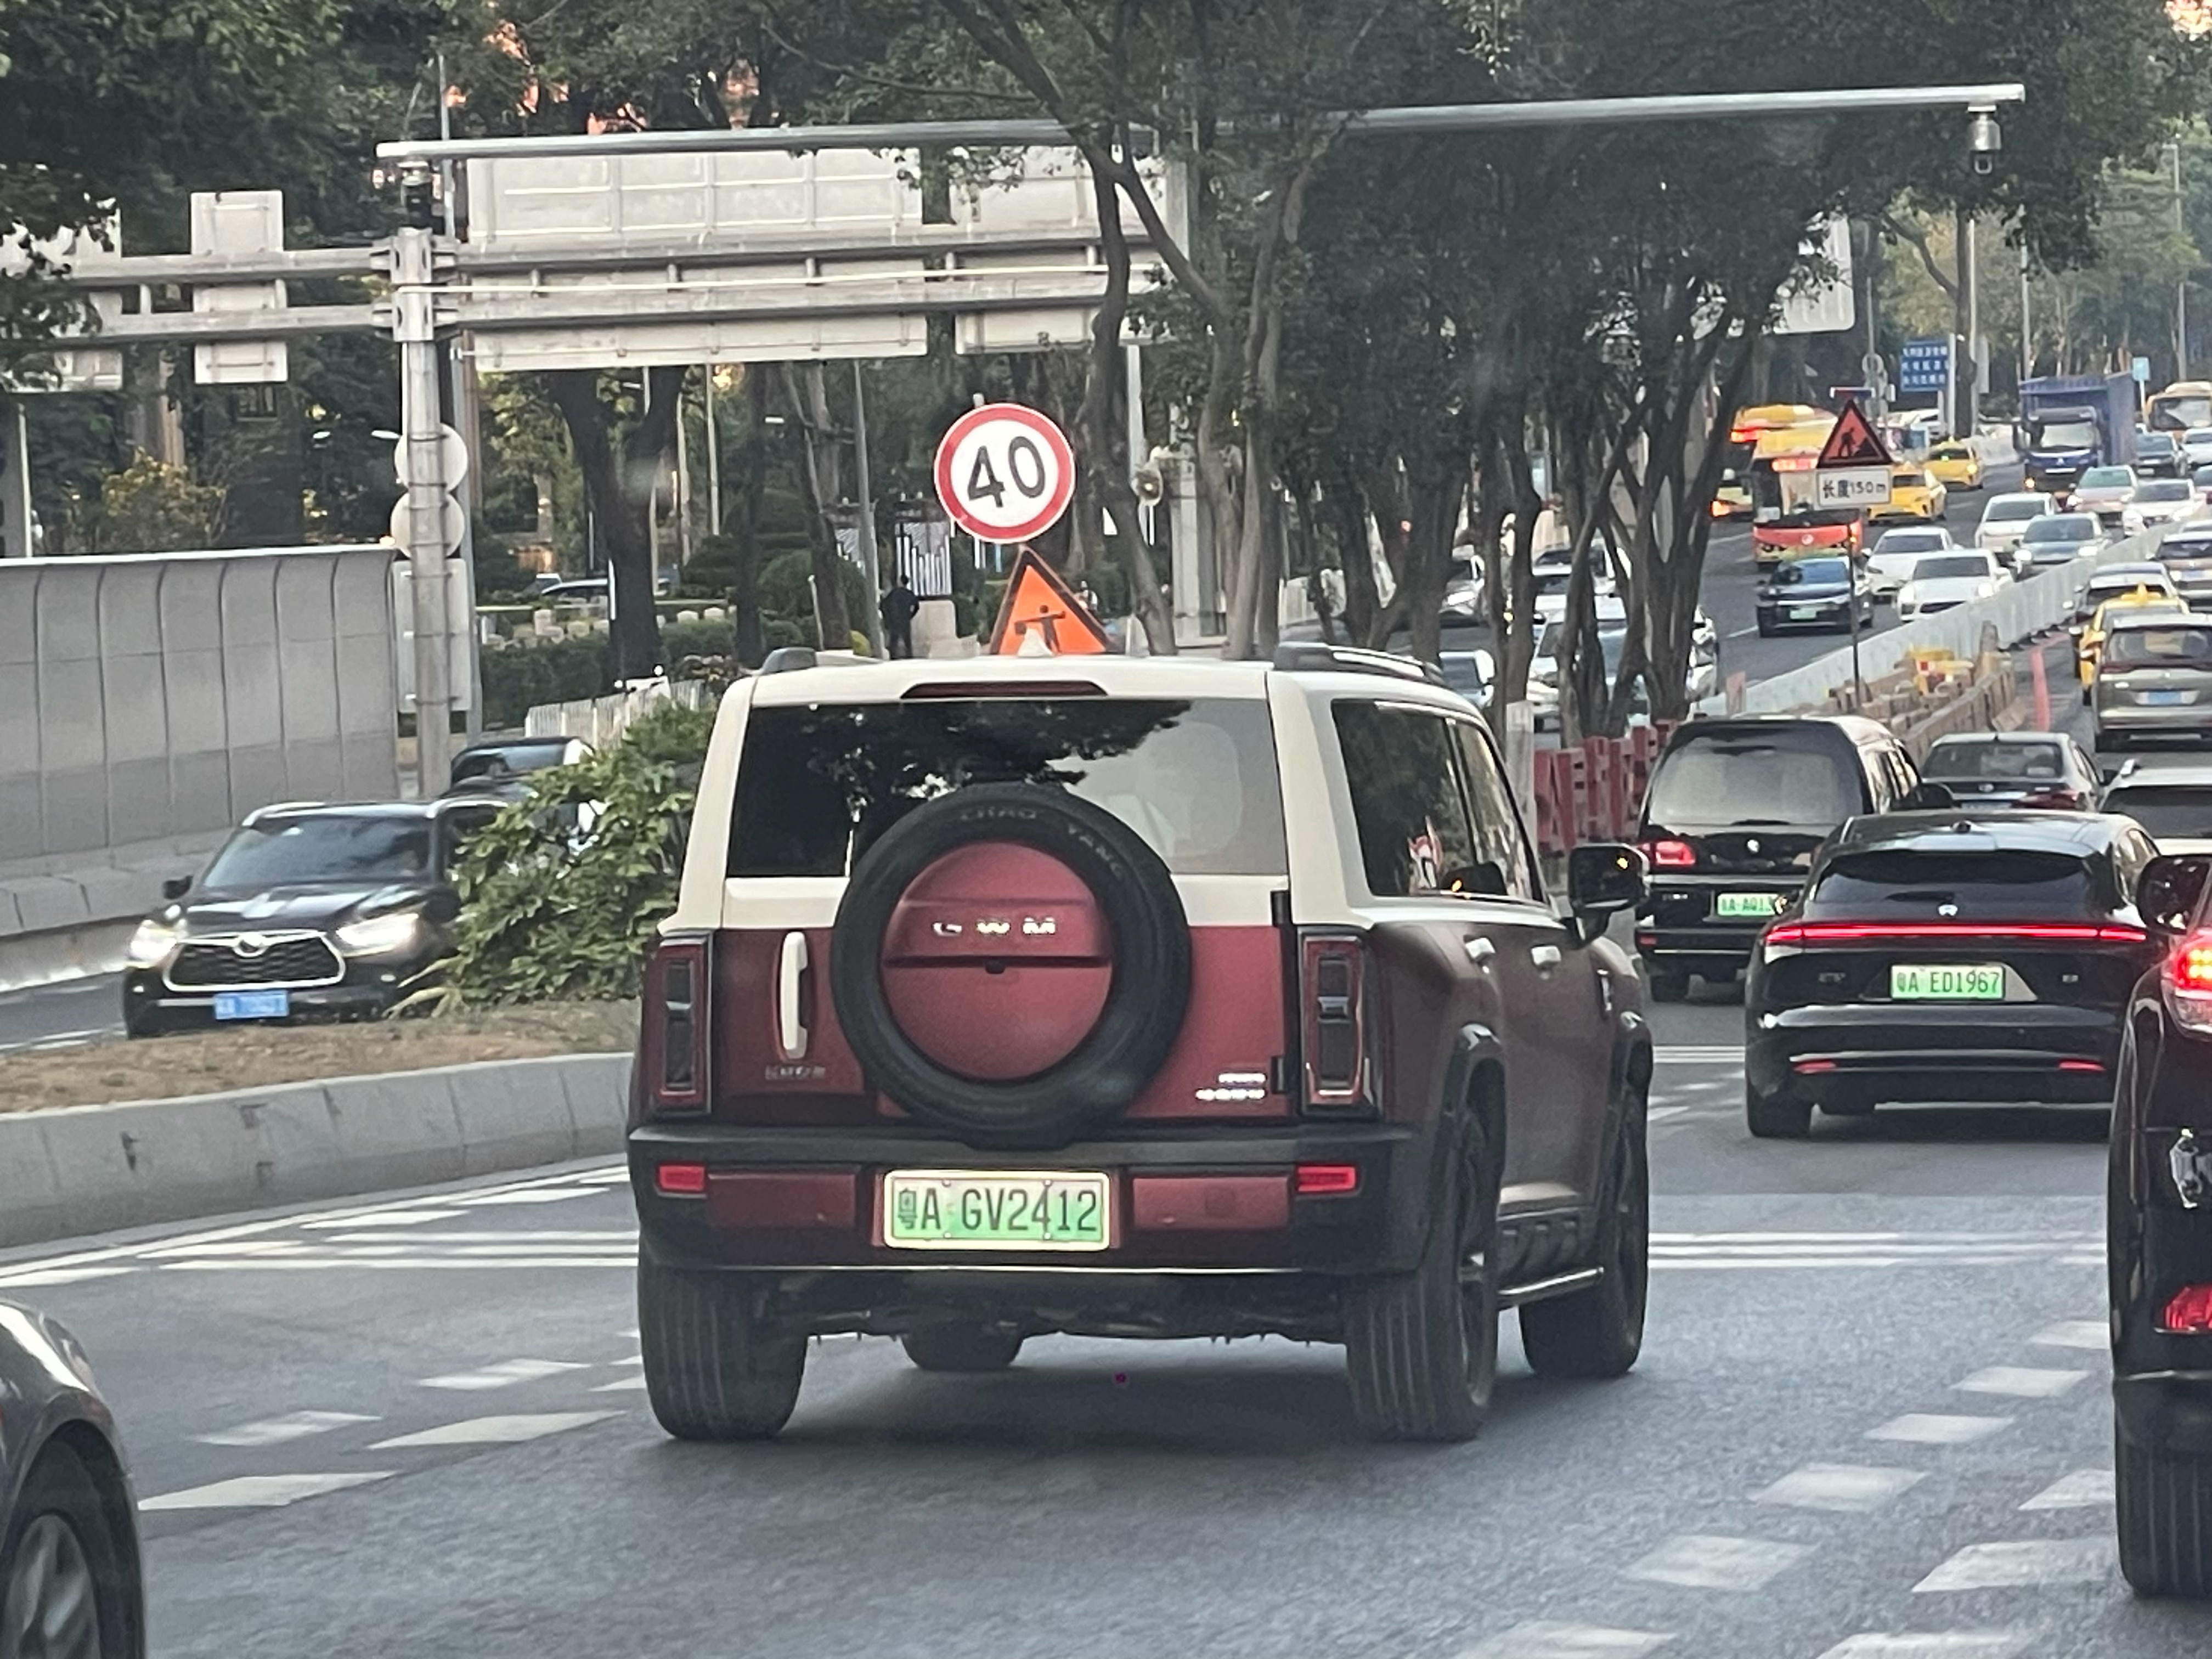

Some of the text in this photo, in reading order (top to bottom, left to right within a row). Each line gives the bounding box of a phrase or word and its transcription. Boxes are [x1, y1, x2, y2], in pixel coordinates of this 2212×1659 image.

[967, 436, 1046, 507] 40
[1823, 479, 1886, 499] 长度150m
[1929, 970, 2000, 993] ED1967
[898, 1187, 1097, 1232] 粤A GV2412
